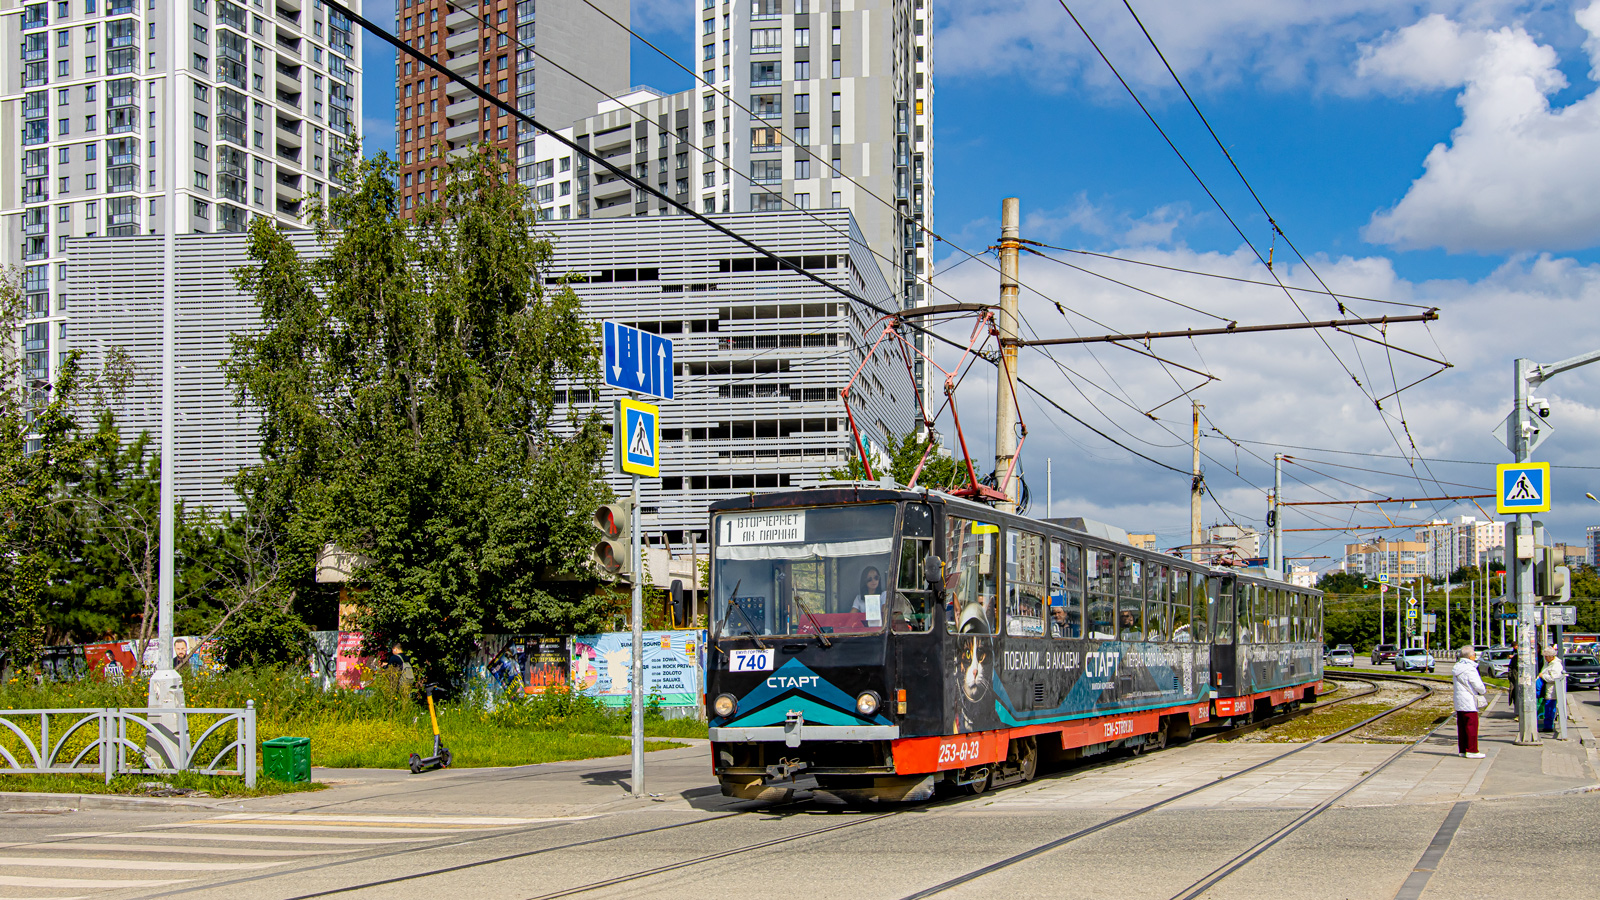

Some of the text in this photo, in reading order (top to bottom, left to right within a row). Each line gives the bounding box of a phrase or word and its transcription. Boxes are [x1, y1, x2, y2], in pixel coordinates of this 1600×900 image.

[737, 513, 799, 528] ВТОРЧЕРМЕТ
[726, 520, 733, 543] 1
[736, 654, 767, 671] 740
[1003, 650, 1080, 672] ПОЕХАЛИ... В АКАДЕМ!
[1085, 651, 1120, 678] СТАРТ
[766, 676, 820, 688] СТАРТ
